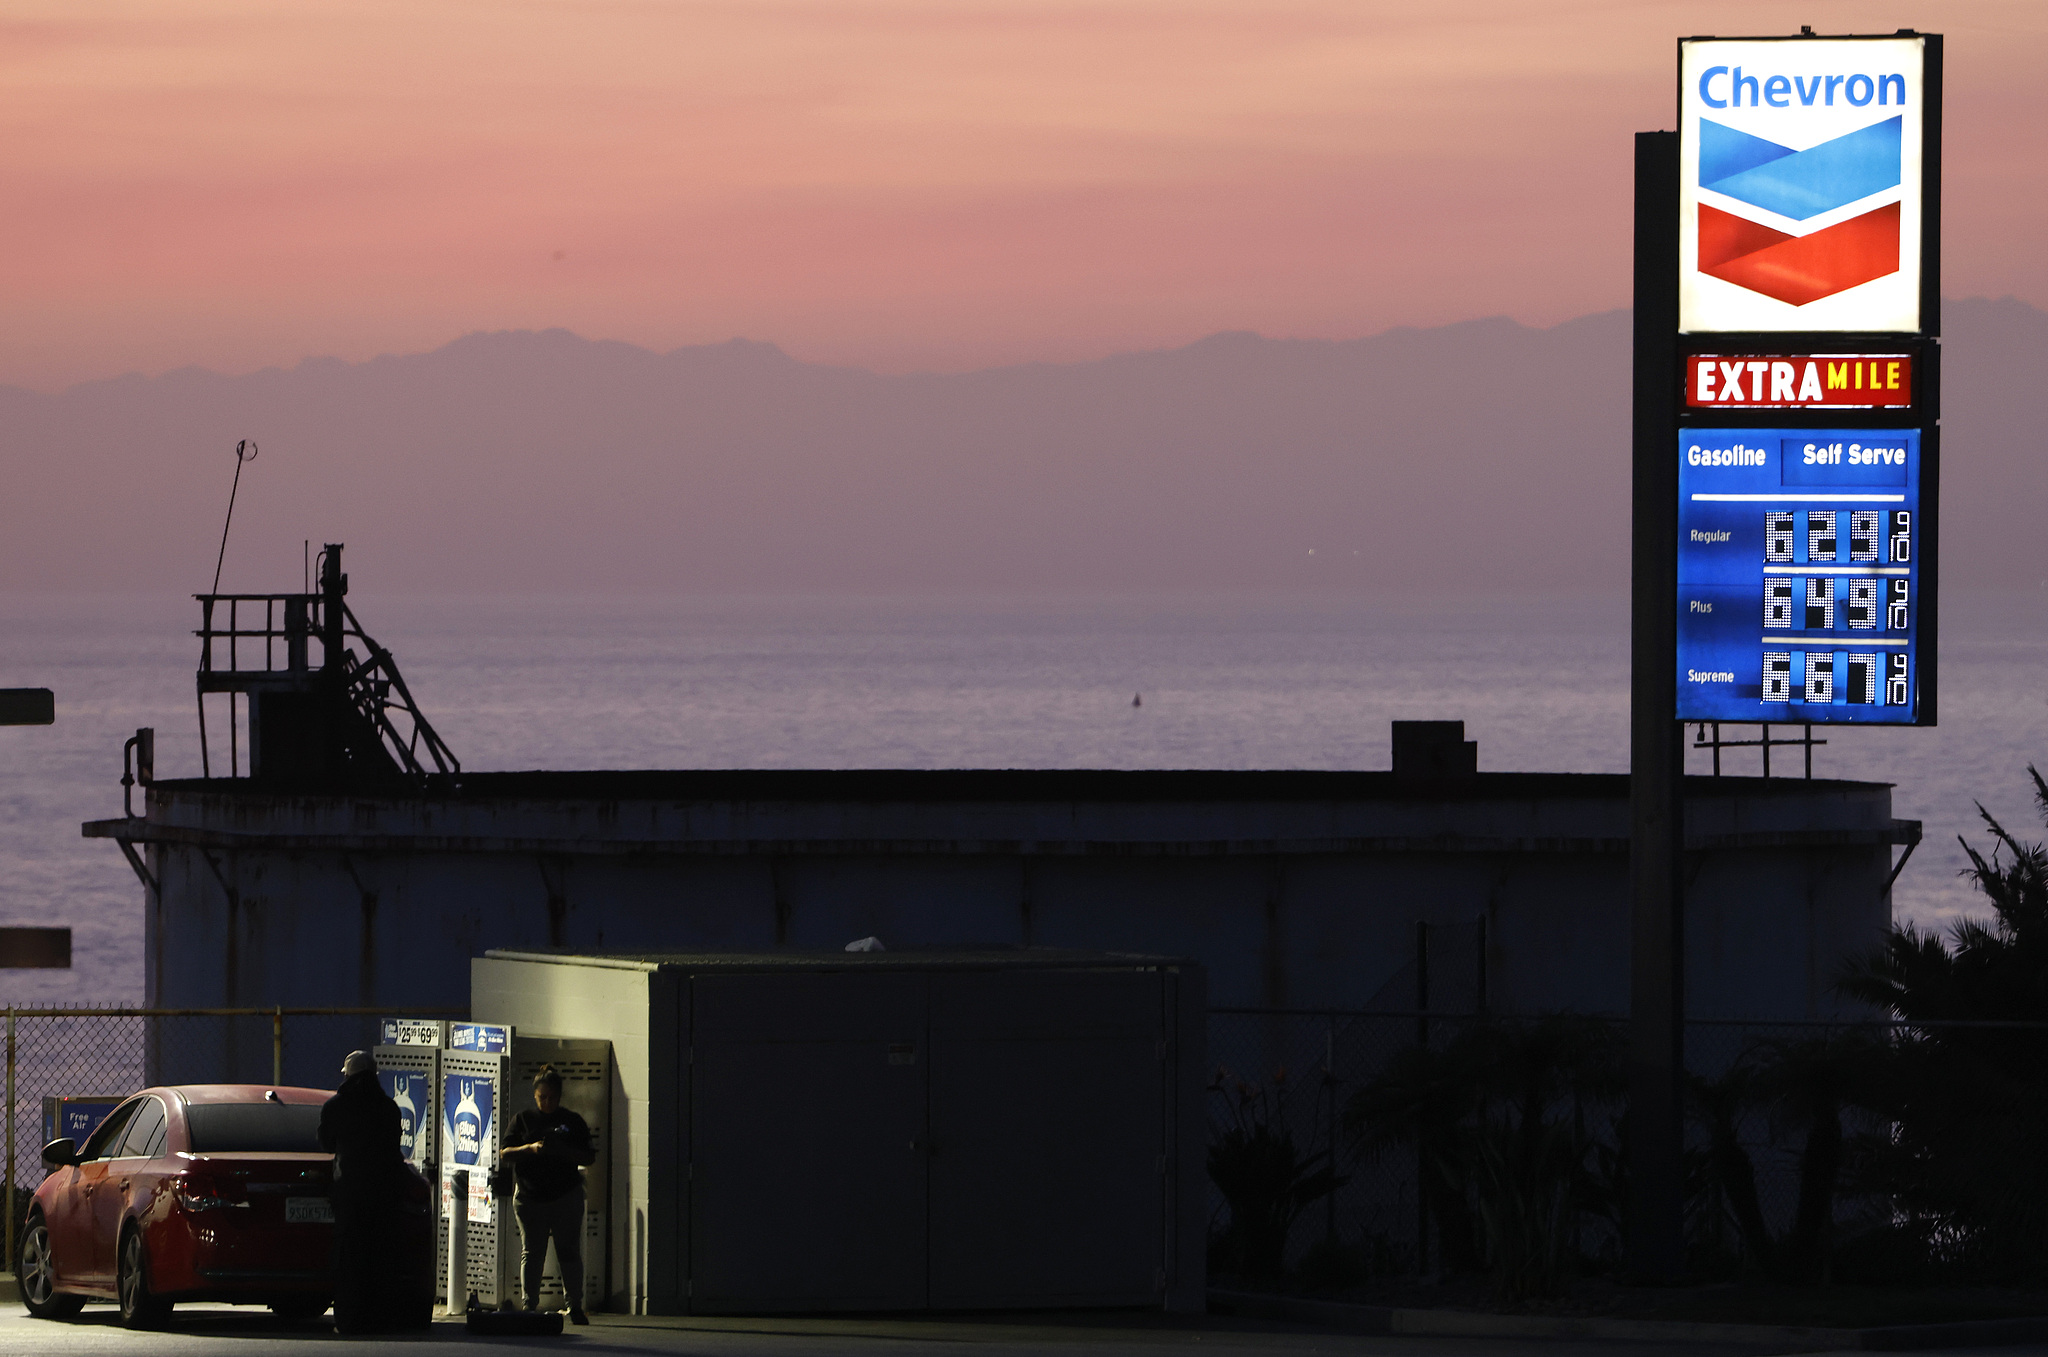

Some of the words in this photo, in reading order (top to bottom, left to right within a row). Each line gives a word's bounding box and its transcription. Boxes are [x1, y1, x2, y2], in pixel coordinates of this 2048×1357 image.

[1699, 65, 1906, 109] Chevron
[1688, 444, 1766, 466] Gasoline
[1803, 443, 1842, 465] Self
[1848, 443, 1906, 465] Serve
[1690, 529, 1731, 544] Regular
[1765, 510, 1879, 563] 629
[1690, 600, 1713, 613] Plus
[1763, 577, 1877, 629] 649
[1688, 669, 1734, 685] Supreme
[1762, 651, 1876, 704] 667
[69, 1112, 89, 1122] Free
[72, 1121, 87, 1130] Air
[459, 1120, 476, 1137] Blue
